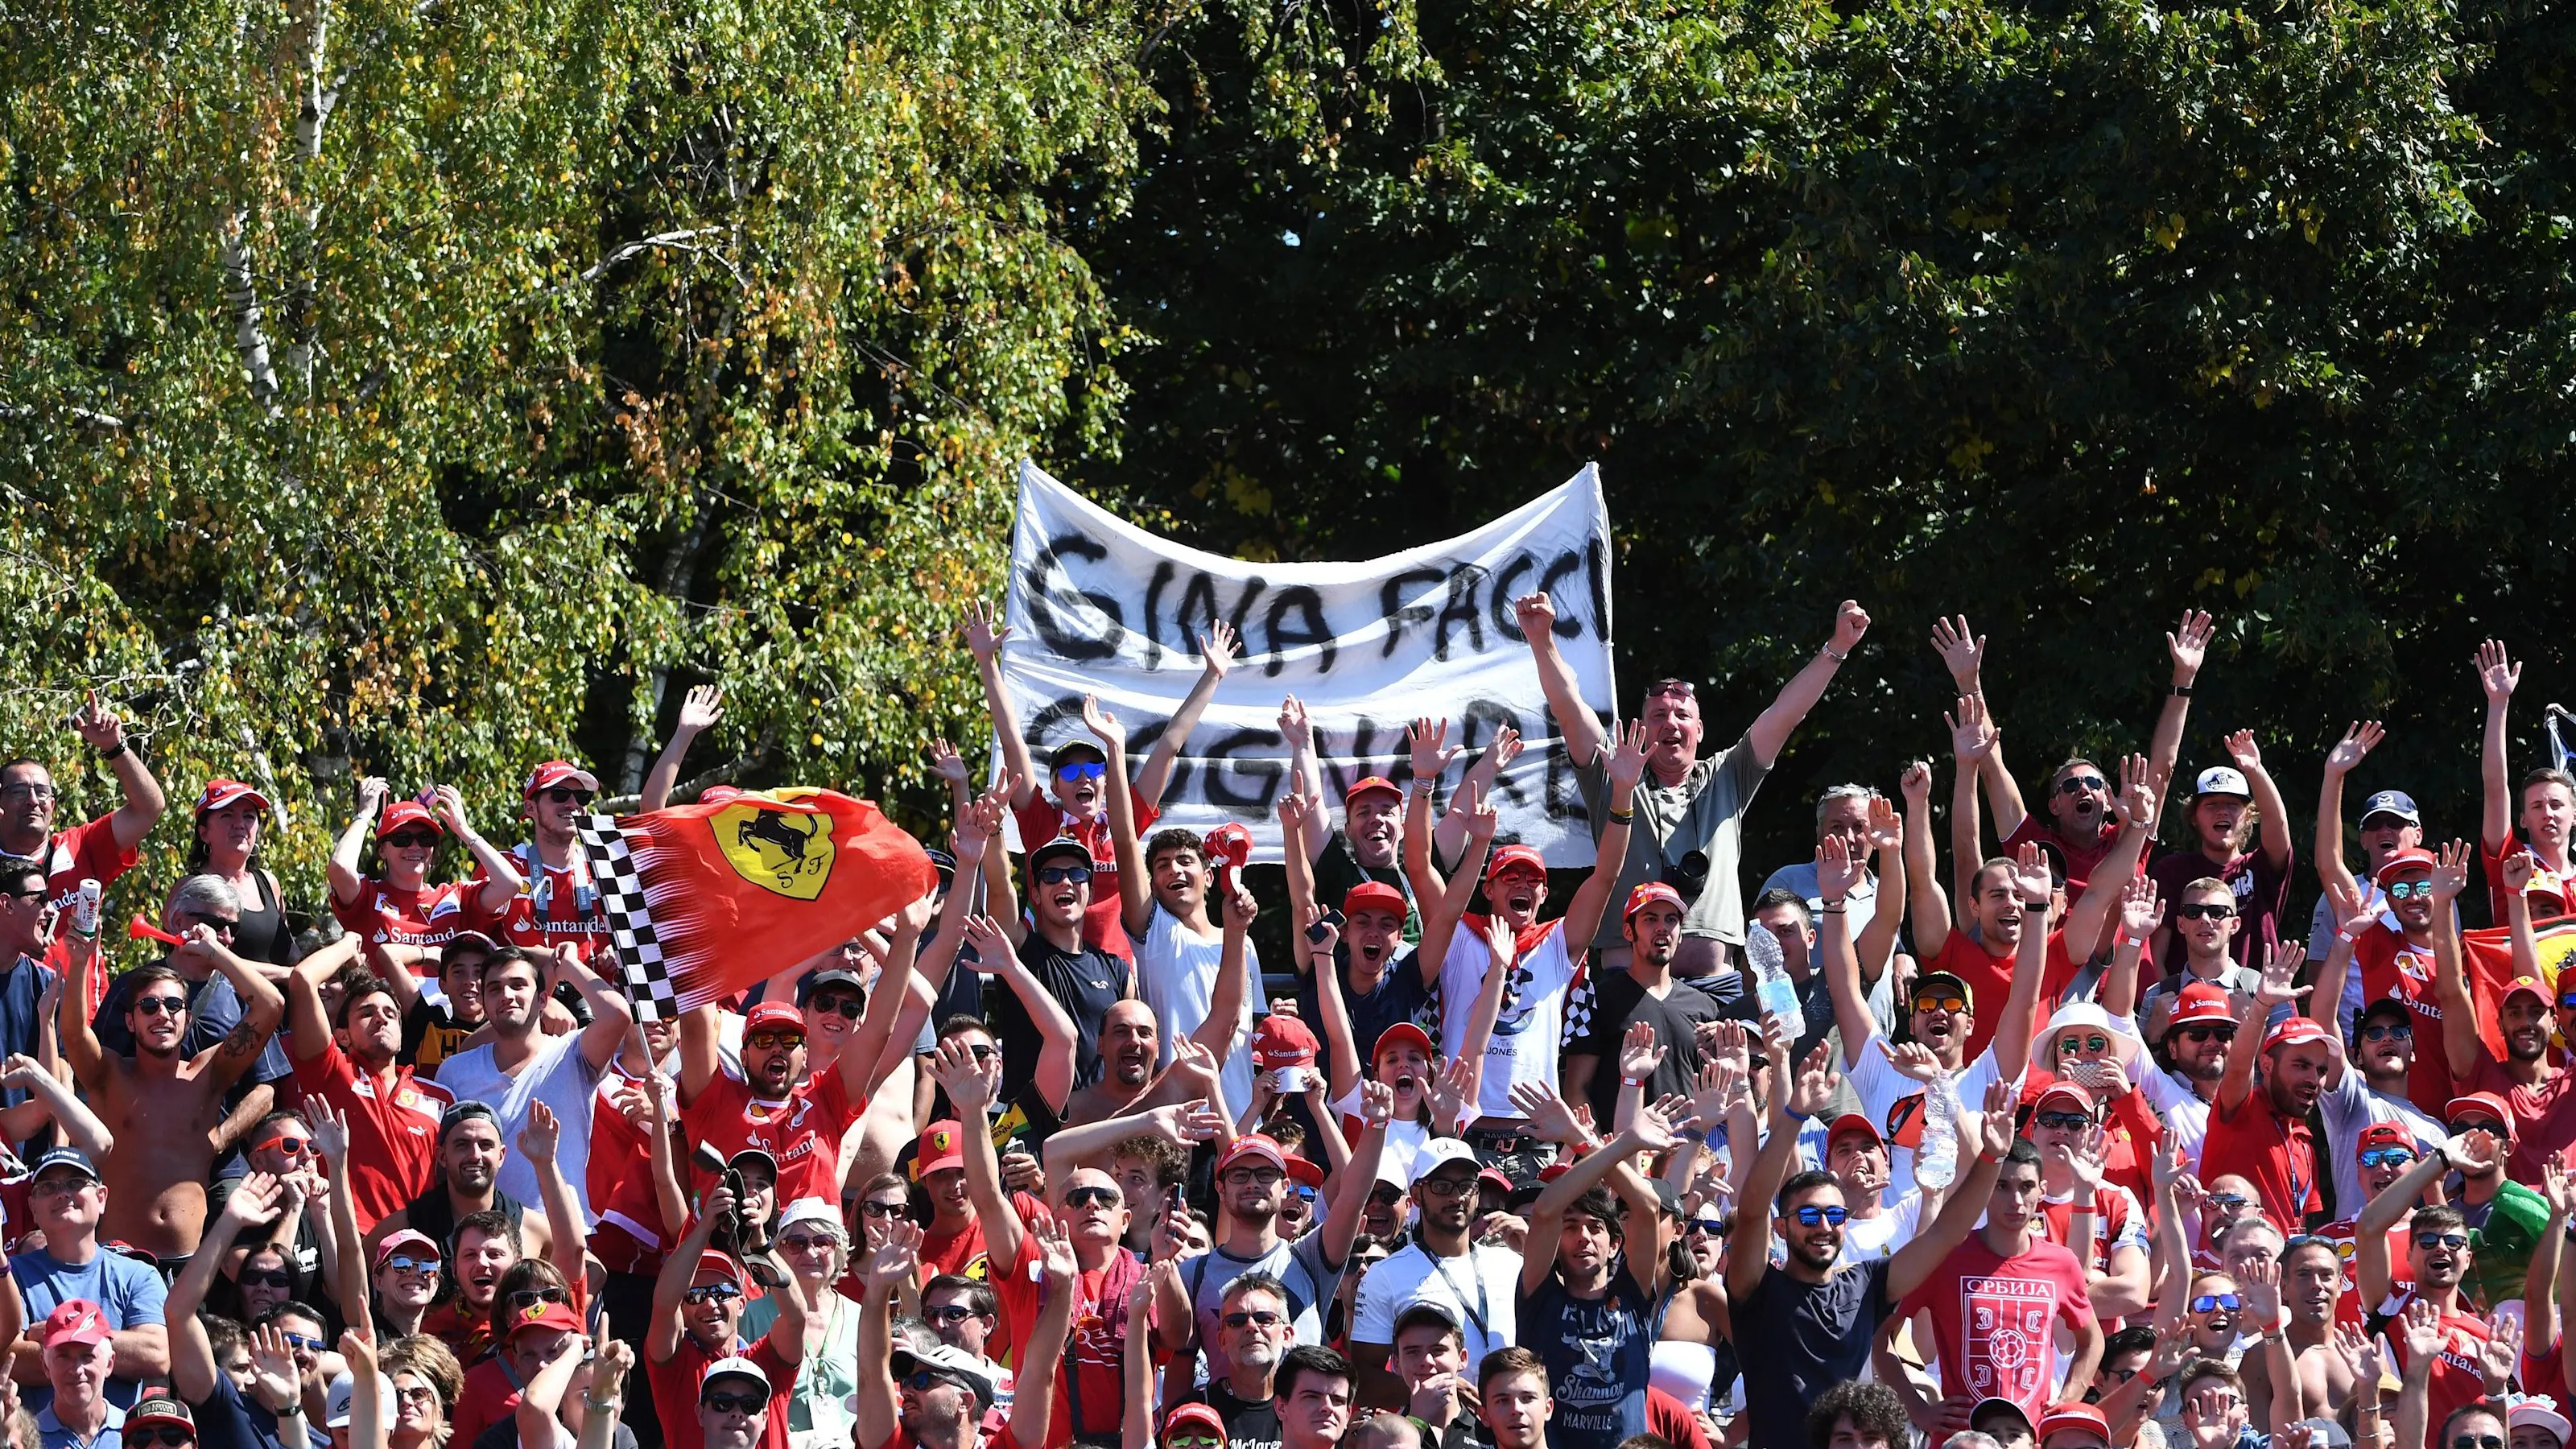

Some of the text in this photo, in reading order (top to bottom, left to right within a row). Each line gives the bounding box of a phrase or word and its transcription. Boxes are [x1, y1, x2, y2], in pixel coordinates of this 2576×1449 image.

[1026, 534, 1608, 677] GINA FACCI
[535, 879, 544, 905] DTAL
[390, 927, 456, 947] Santand
[2403, 989, 2443, 1020] Santa
[1487, 1047, 1517, 1057] JONES
[762, 1129, 815, 1163] Santand
[1484, 1131, 1523, 1139] NAVIGAR
[1967, 1279, 2050, 1297] СРБИЈА
[1555, 1373, 1625, 1406] Shannon
[1563, 1410, 1613, 1431] MARVILLE
